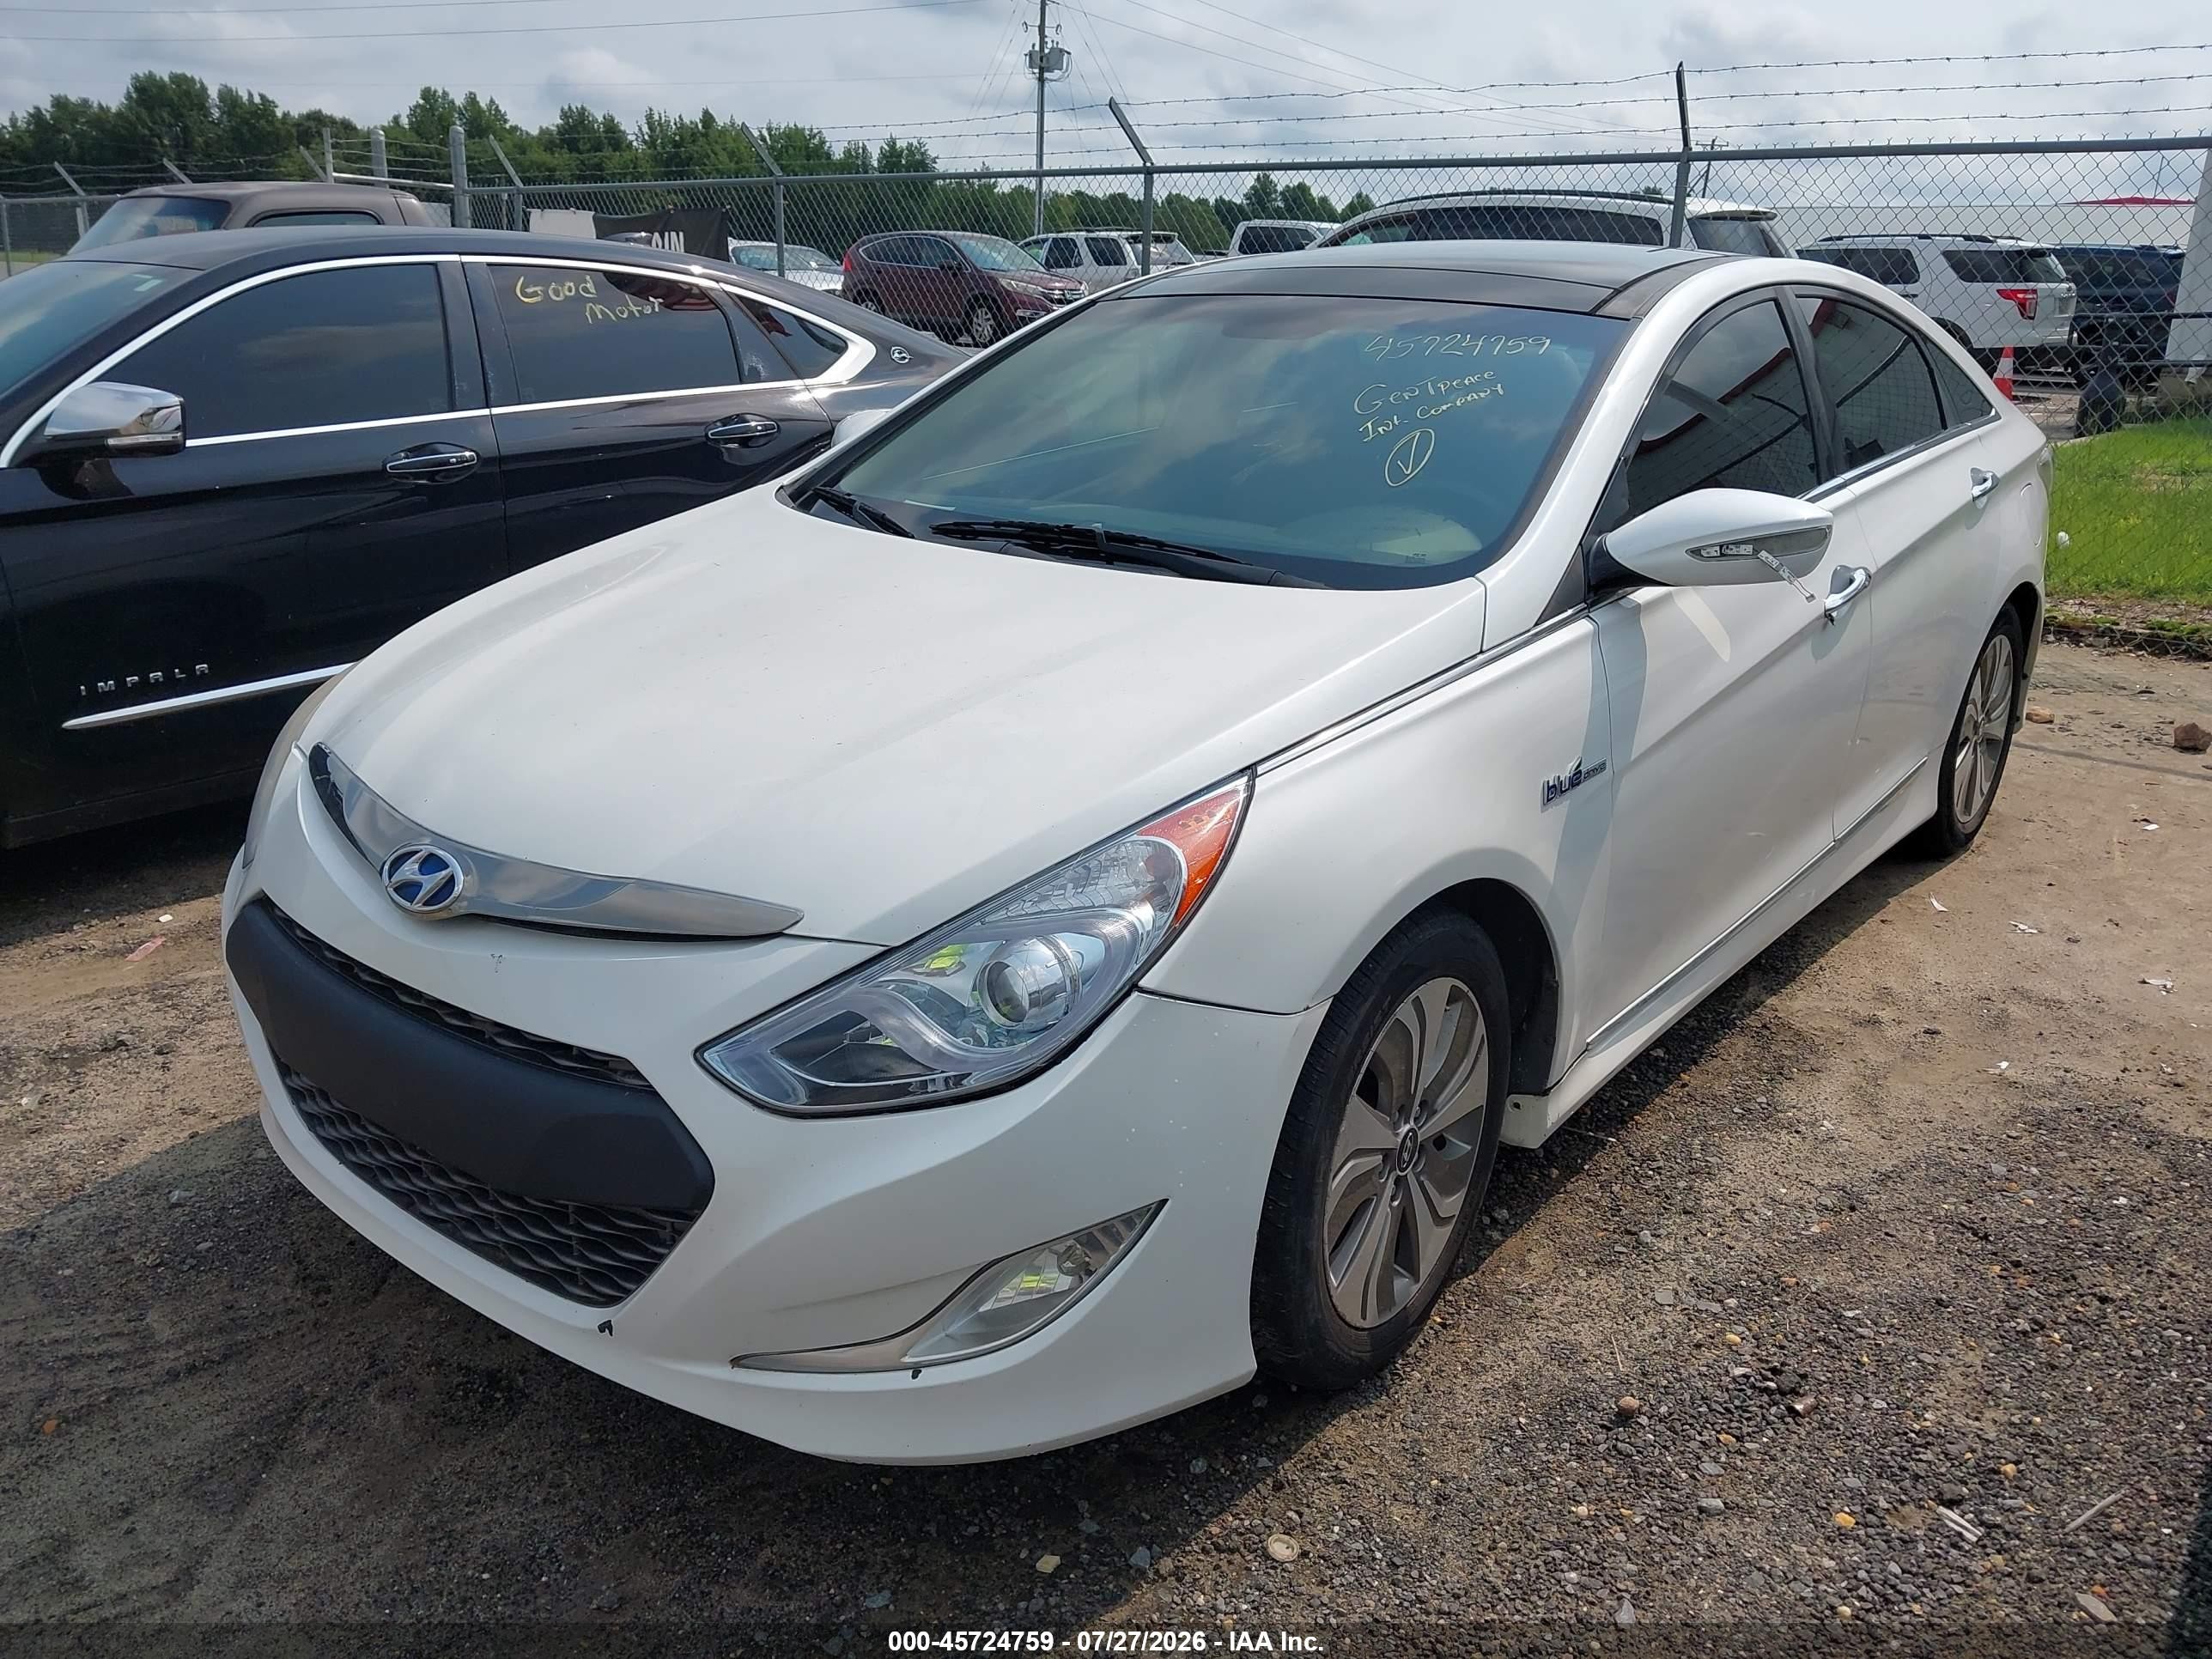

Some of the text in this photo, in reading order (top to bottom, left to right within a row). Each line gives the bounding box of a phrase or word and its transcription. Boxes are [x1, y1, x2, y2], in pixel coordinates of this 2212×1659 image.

[515, 275, 597, 303] Good
[1364, 333, 1551, 362] 45724759
[81, 664, 209, 696] IMPALA
[1542, 769, 1583, 805] blue
